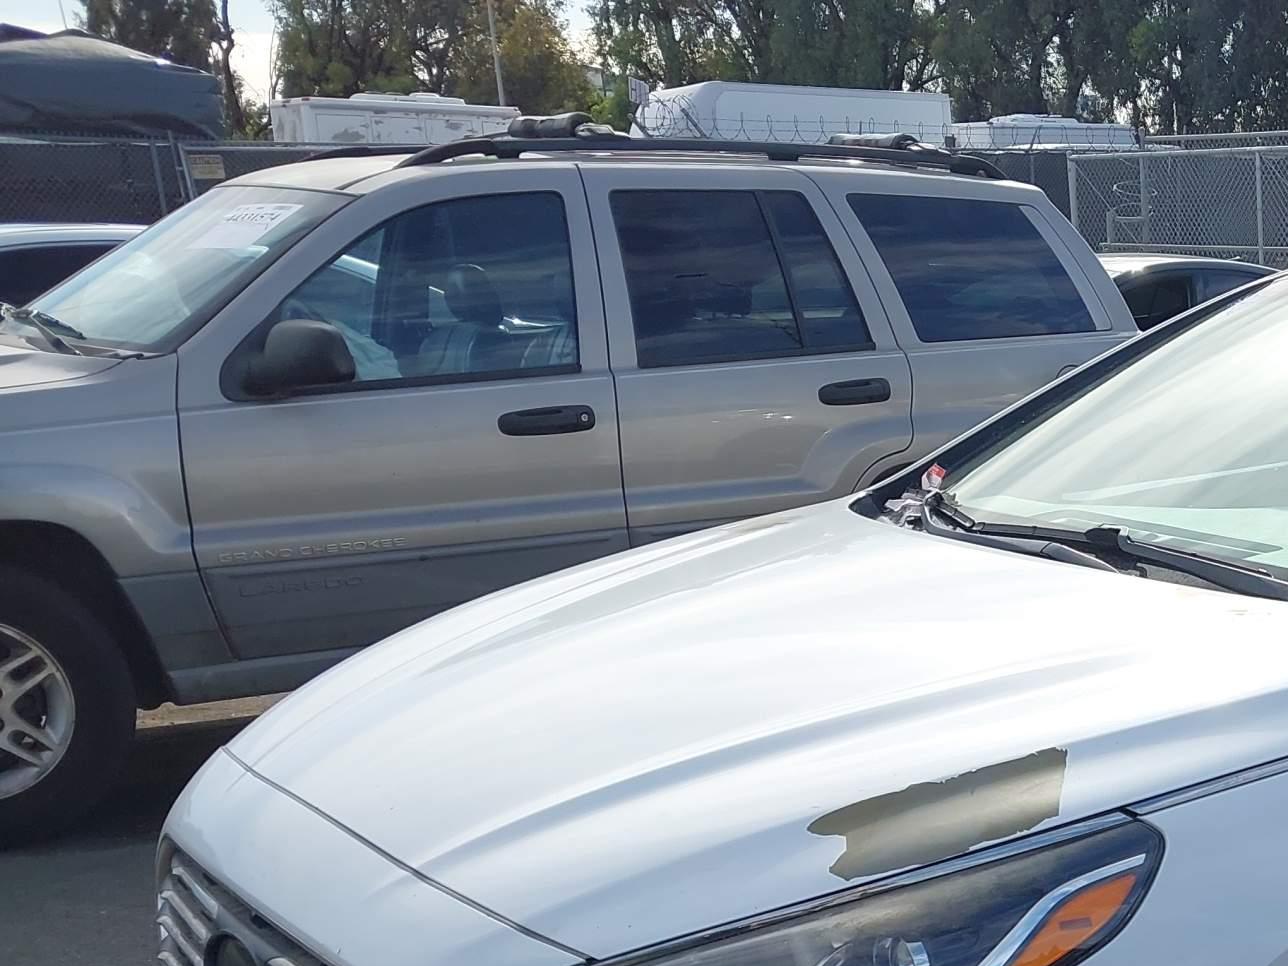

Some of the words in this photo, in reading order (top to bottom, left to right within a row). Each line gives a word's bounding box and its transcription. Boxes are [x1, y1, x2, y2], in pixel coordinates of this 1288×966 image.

[219, 549, 293, 563] GRAND
[300, 537, 409, 557] CHEROKEE
[240, 576, 363, 598] LAREDO
